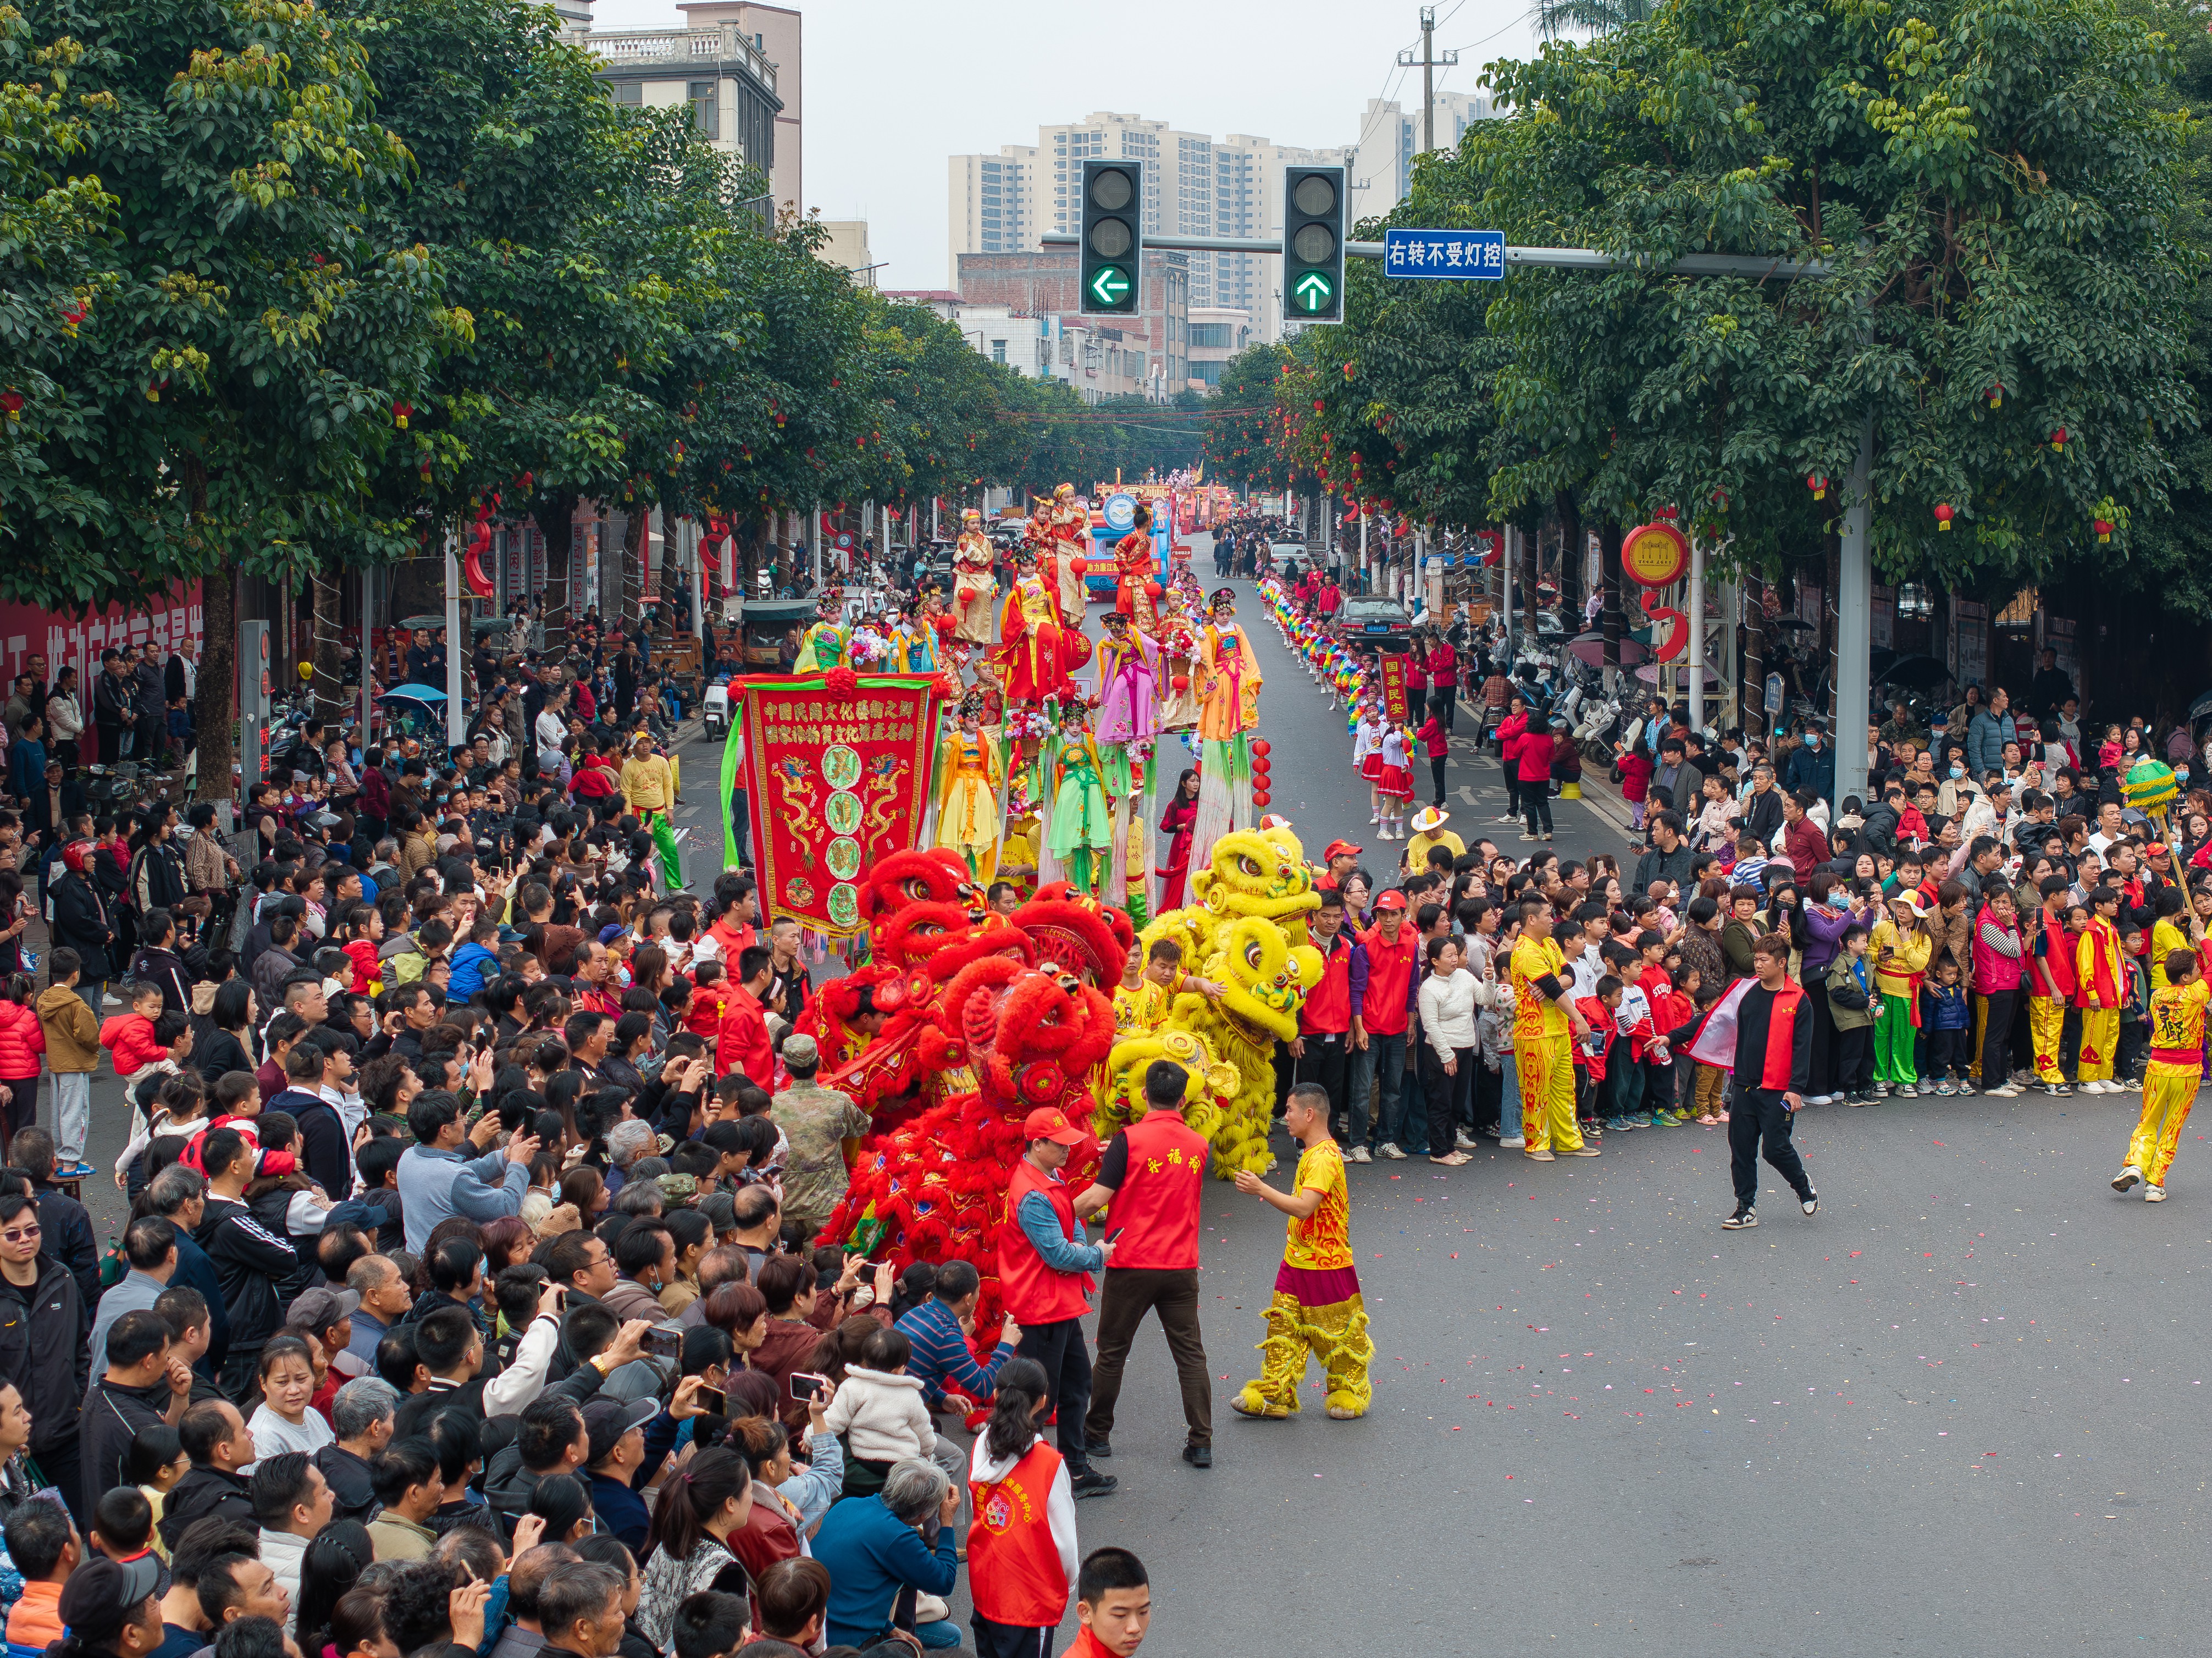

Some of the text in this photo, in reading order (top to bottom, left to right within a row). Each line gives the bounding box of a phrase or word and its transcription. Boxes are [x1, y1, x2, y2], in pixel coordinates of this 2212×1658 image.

[1389, 240, 1501, 268] 右转不受灯控
[483, 535, 494, 617] 马动
[573, 526, 583, 616] 电动三轮车
[1385, 661, 1404, 715] 国泰民安
[1053, 1115, 1063, 1126] 港
